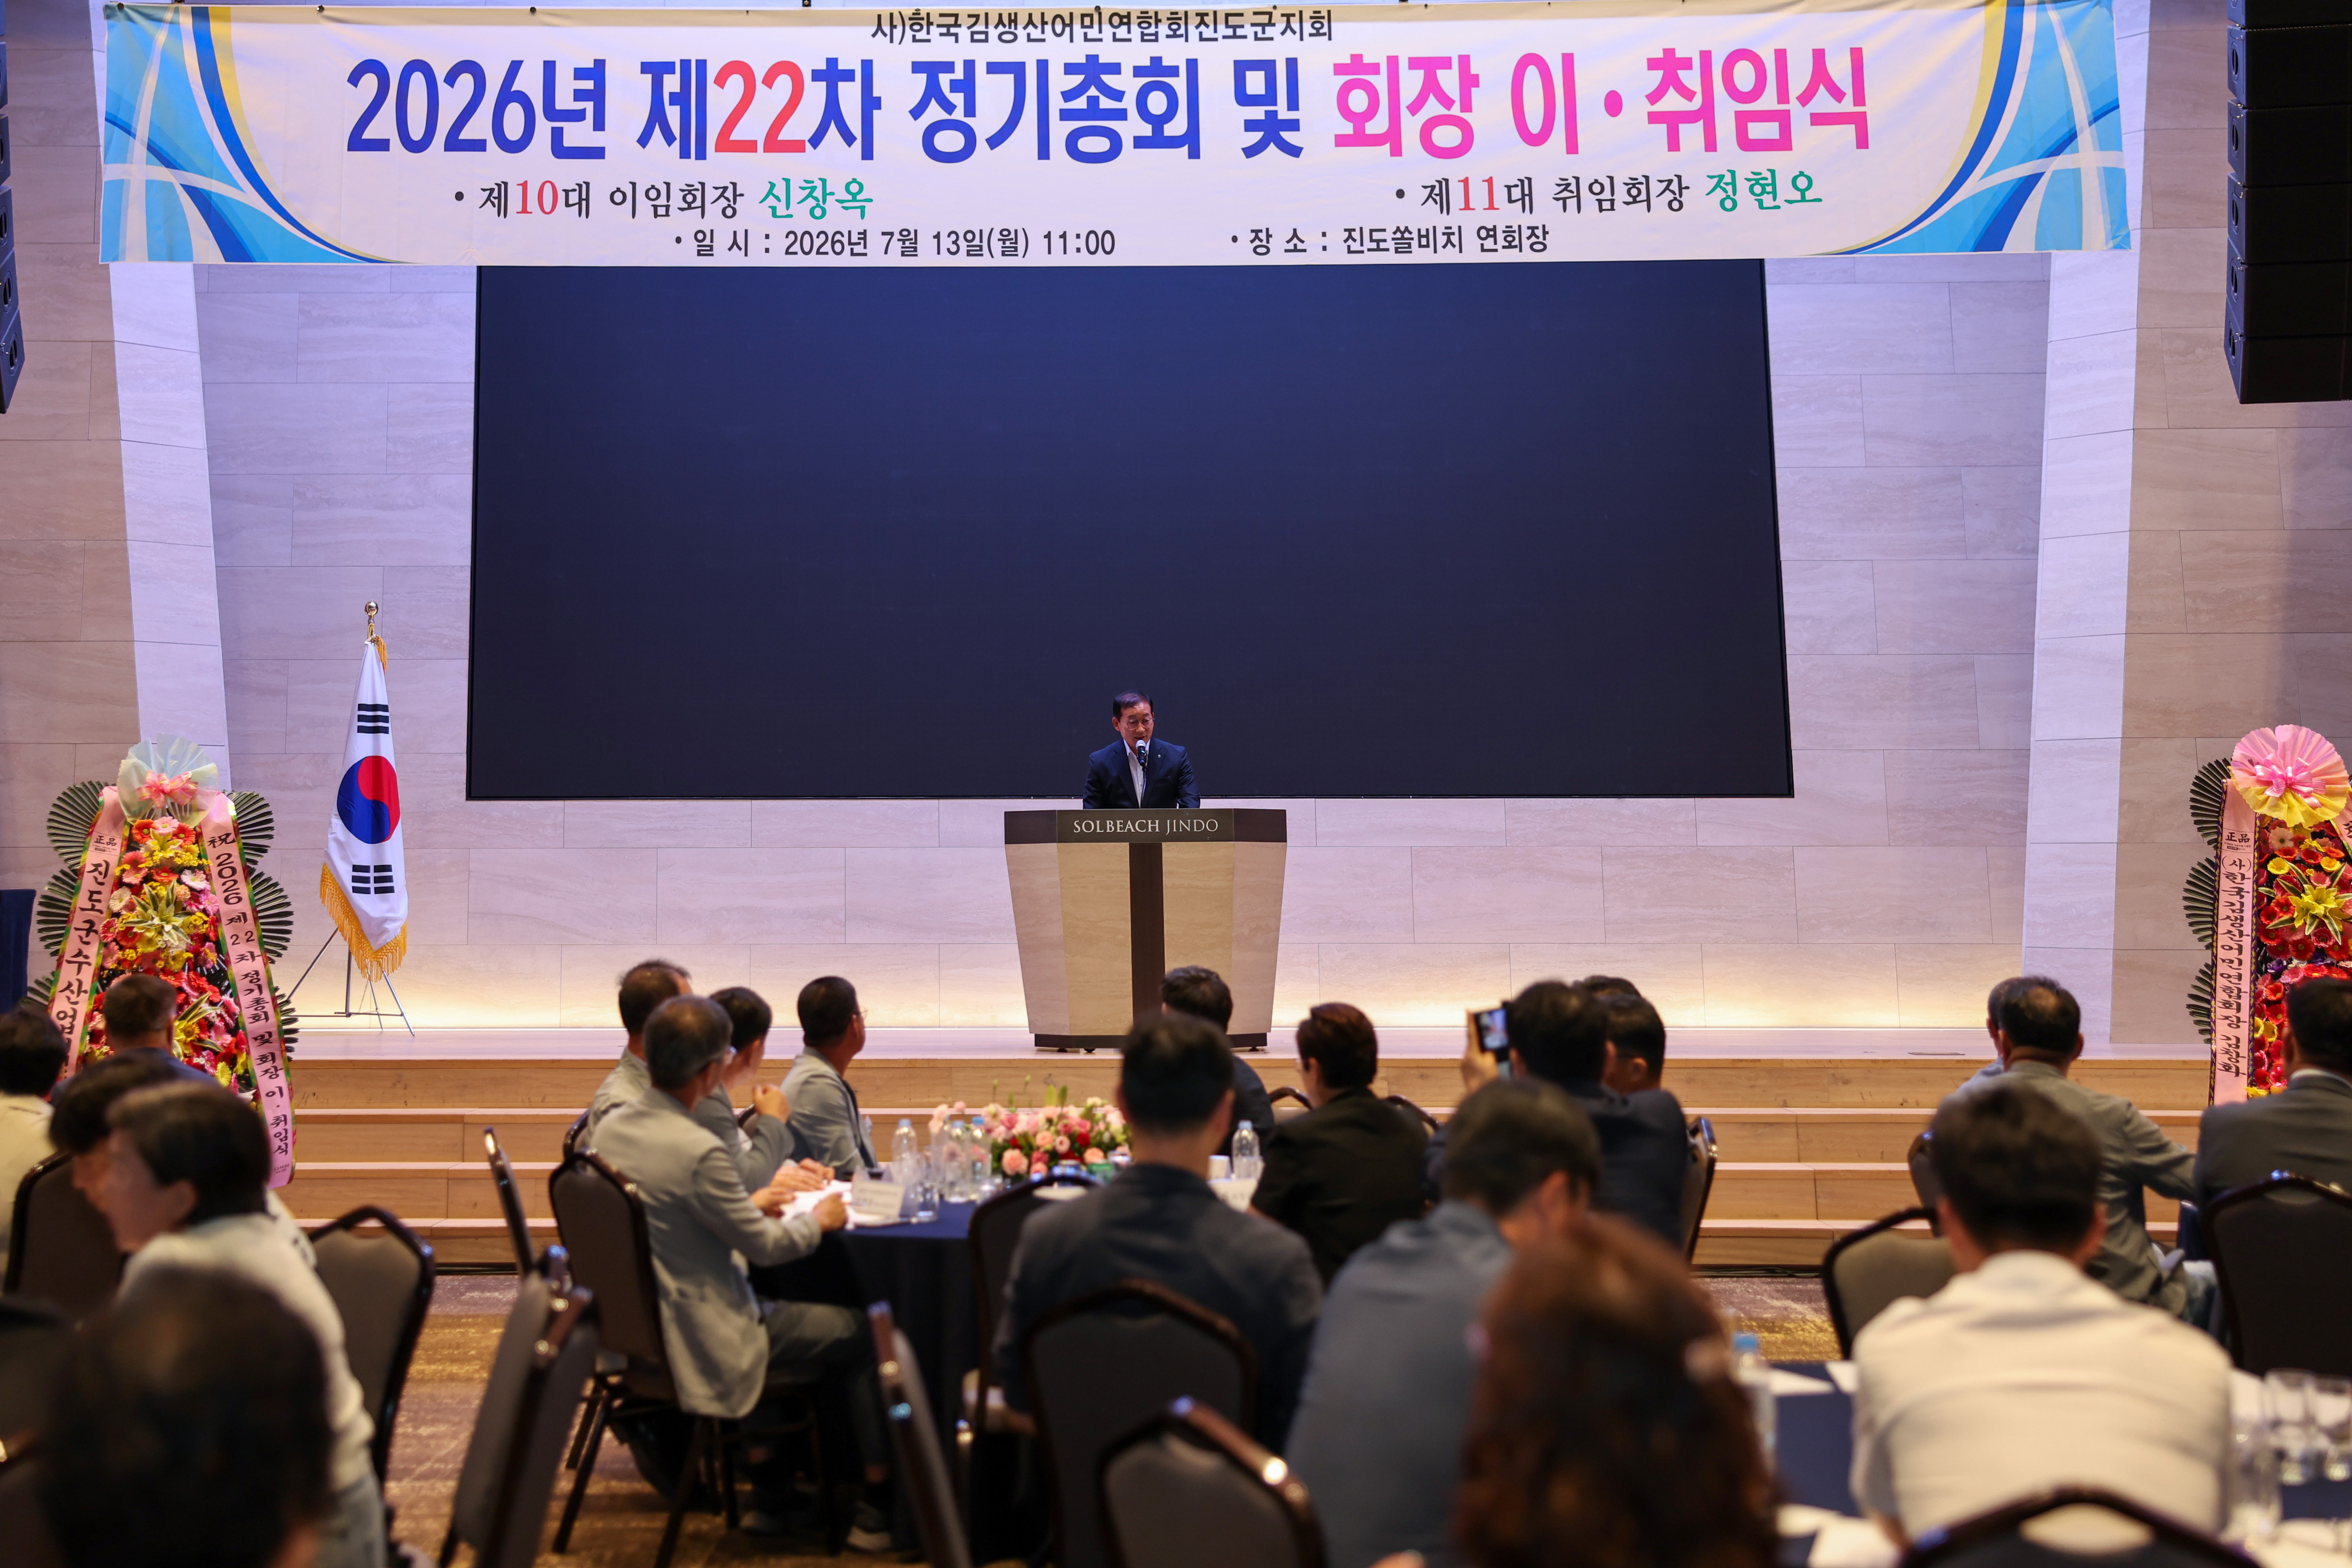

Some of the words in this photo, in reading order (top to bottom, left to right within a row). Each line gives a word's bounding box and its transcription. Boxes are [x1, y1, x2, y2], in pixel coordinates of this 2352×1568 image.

[871, 9, 1332, 45] 사)한국김생산어민연합회진도군지회
[347, 59, 606, 160] 2026년
[636, 57, 882, 161] 제22차
[908, 54, 1200, 164] 정기총회
[1233, 57, 1304, 159] 및
[1333, 54, 1480, 160] 회장
[479, 180, 590, 219] 제10대
[610, 181, 744, 220] 이임회장
[759, 178, 873, 220] 신창옥
[1421, 176, 1533, 216] 제11대
[1552, 174, 1690, 214] 취임회장
[1706, 169, 1822, 212] 정현오
[694, 229, 714, 257] 일
[728, 229, 748, 257] 시
[785, 229, 867, 256] 2026년
[881, 228, 918, 257] 7월
[933, 228, 1029, 259] 13일(월)
[1044, 230, 1115, 255] 11:00
[1249, 227, 1272, 256] 장
[1284, 228, 1307, 253] 소
[1343, 225, 1463, 254] 진도쏠비치
[1477, 224, 1549, 253] 연회장
[94, 835, 117, 846] 正品
[1073, 820, 1160, 833] SOLBEACH
[1165, 819, 1218, 835] JINDO
[2225, 832, 2250, 843] 正品
[216, 853, 243, 905] 2026
[56, 860, 110, 1066] 진도군수산업
[240, 970, 269, 1024] 정기총회
[251, 1031, 273, 1047] 및
[2217, 1034, 2247, 1077] 김창화
[255, 1052, 283, 1080] 회장
